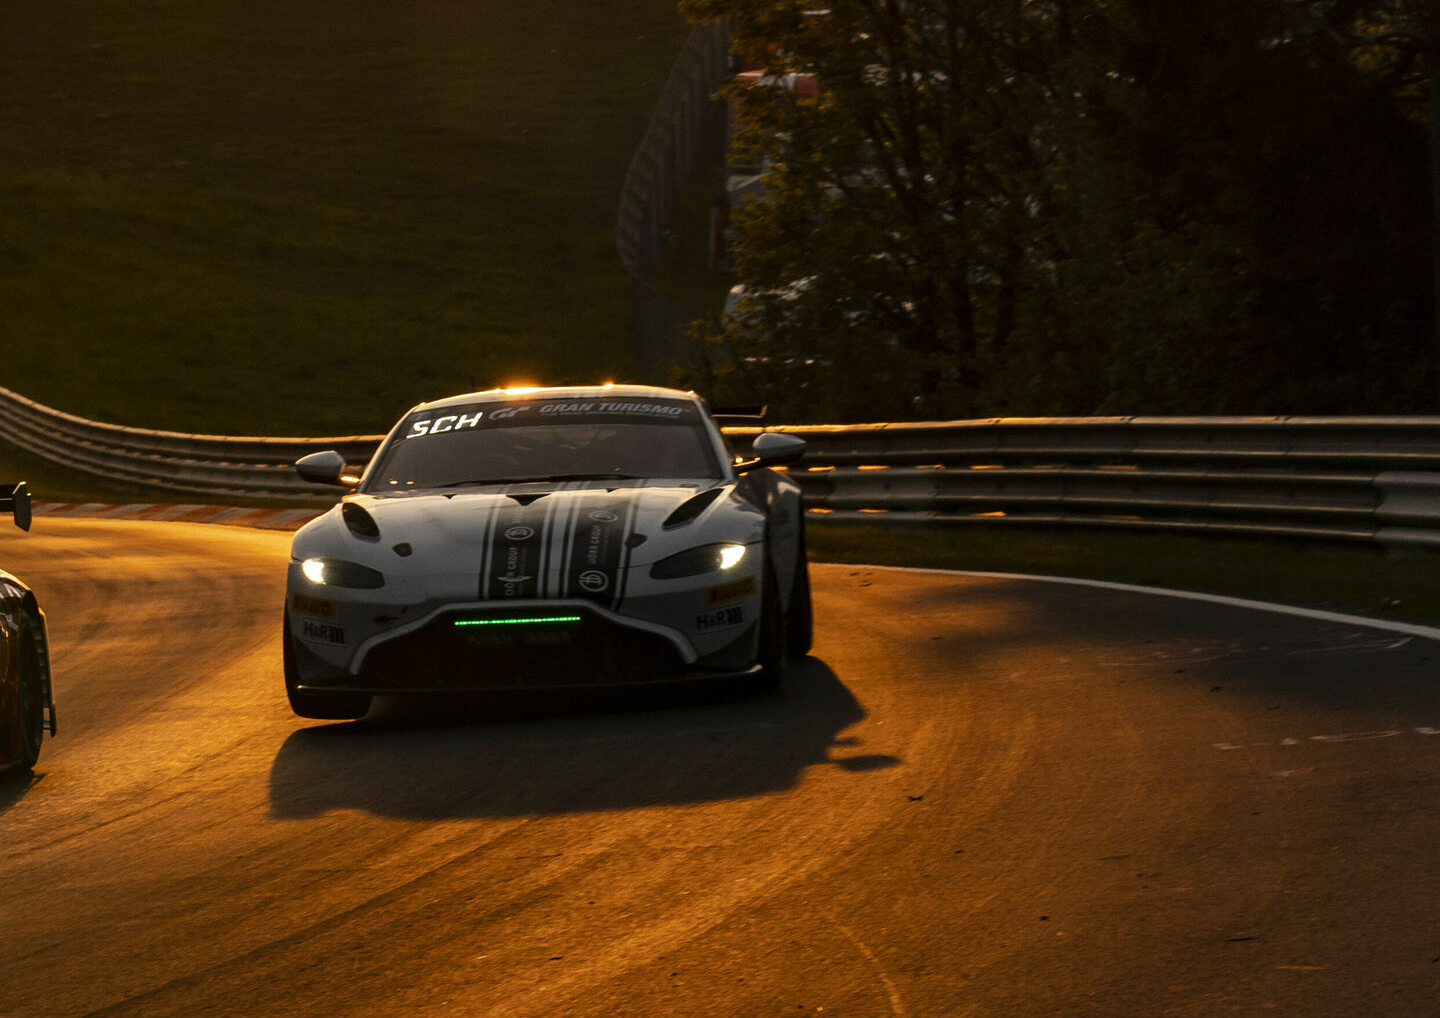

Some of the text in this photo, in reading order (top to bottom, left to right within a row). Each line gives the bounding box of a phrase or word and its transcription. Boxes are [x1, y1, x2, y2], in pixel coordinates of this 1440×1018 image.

[539, 403, 594, 414] GRAN
[597, 402, 683, 416] TURISMO
[406, 412, 483, 439] SCH
